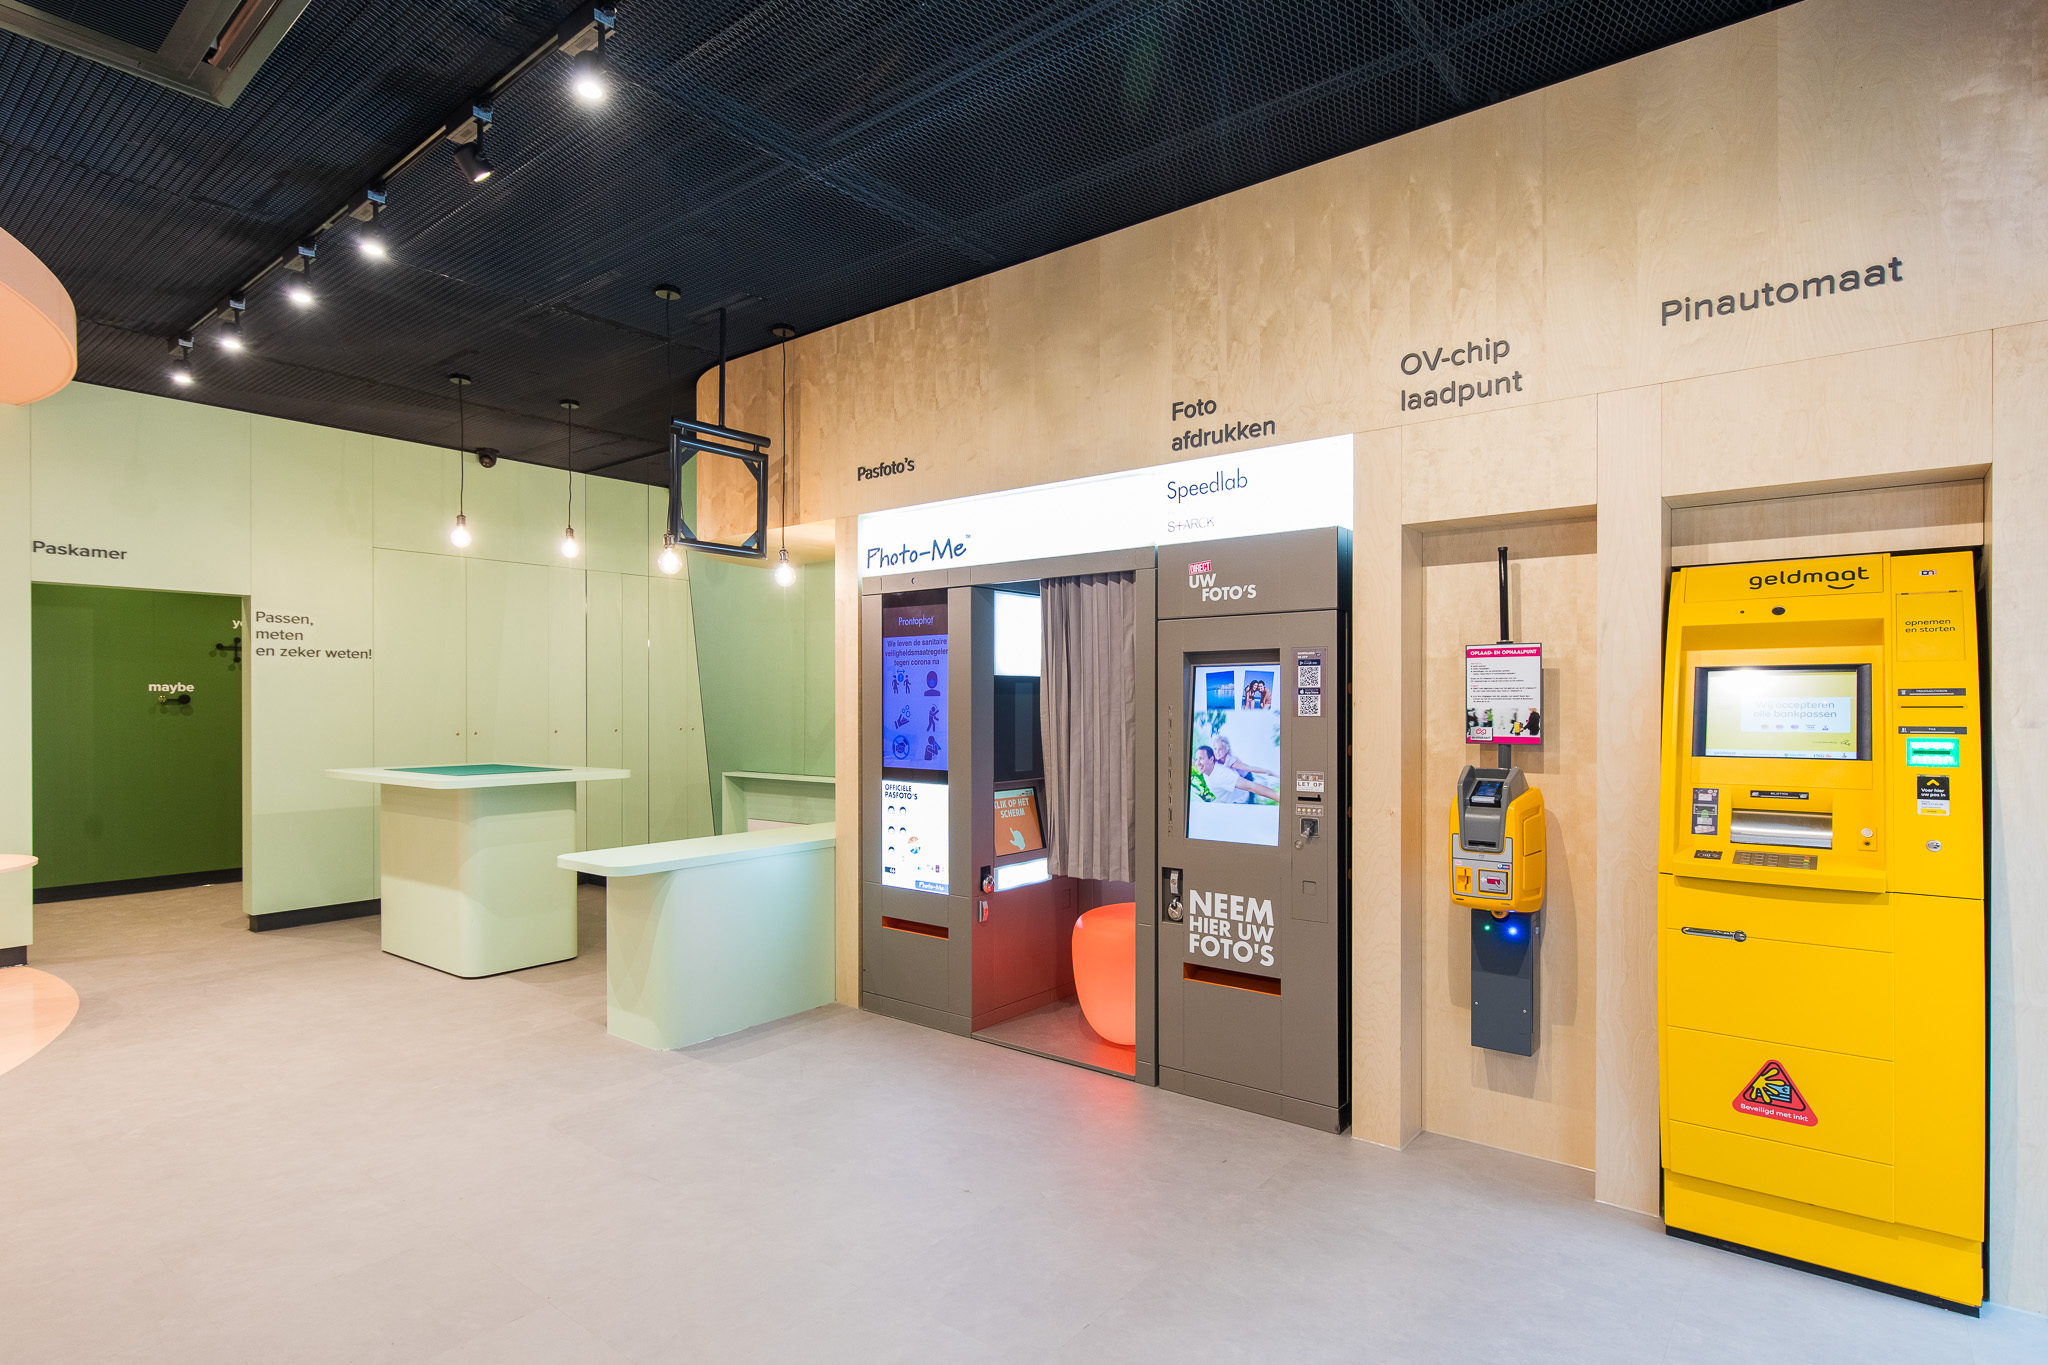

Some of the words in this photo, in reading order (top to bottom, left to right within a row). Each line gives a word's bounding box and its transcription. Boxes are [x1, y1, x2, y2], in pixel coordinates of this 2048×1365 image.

[1661, 256, 1904, 327] Pinautomaat
[1400, 337, 1510, 375] OV-chip
[1401, 370, 1523, 411] laadpunt
[1171, 398, 1217, 421] Foto
[1171, 419, 1276, 451] afdrukken
[857, 457, 915, 481] Pasfoto's
[1167, 468, 1248, 504] Speedlab
[32, 540, 128, 560] Paskamer
[867, 537, 967, 569] Photo-Me
[1189, 561, 1211, 575] DIRECT
[1188, 573, 1217, 589] UW
[1749, 566, 1870, 590] geldmaat
[1202, 584, 1257, 602] FOTO'S
[255, 611, 314, 626] Passen,
[1905, 619, 1951, 627] opnemen
[255, 629, 304, 641] meten
[921, 638, 947, 646] sanitaire
[255, 647, 275, 657] en
[280, 646, 321, 658] zeker
[325, 648, 373, 660] weten!
[148, 681, 195, 694] maybe
[1753, 710, 1772, 718] alle
[1773, 710, 1837, 719] bankpassen
[1775, 701, 1835, 710] accepteren
[884, 791, 918, 801] PASFOTO'S
[1008, 799, 1017, 808] OP
[1018, 797, 1030, 807] HET
[1000, 808, 1026, 819] SCHERM
[1189, 889, 1275, 926] NEEM
[1189, 915, 1232, 938] HIER
[1237, 923, 1275, 944] UW
[1189, 933, 1275, 967] FOTO'S
[1740, 1103, 1775, 1115] Beveiligd
[1775, 1110, 1792, 1119] met
[1793, 1113, 1809, 1122] inkt
